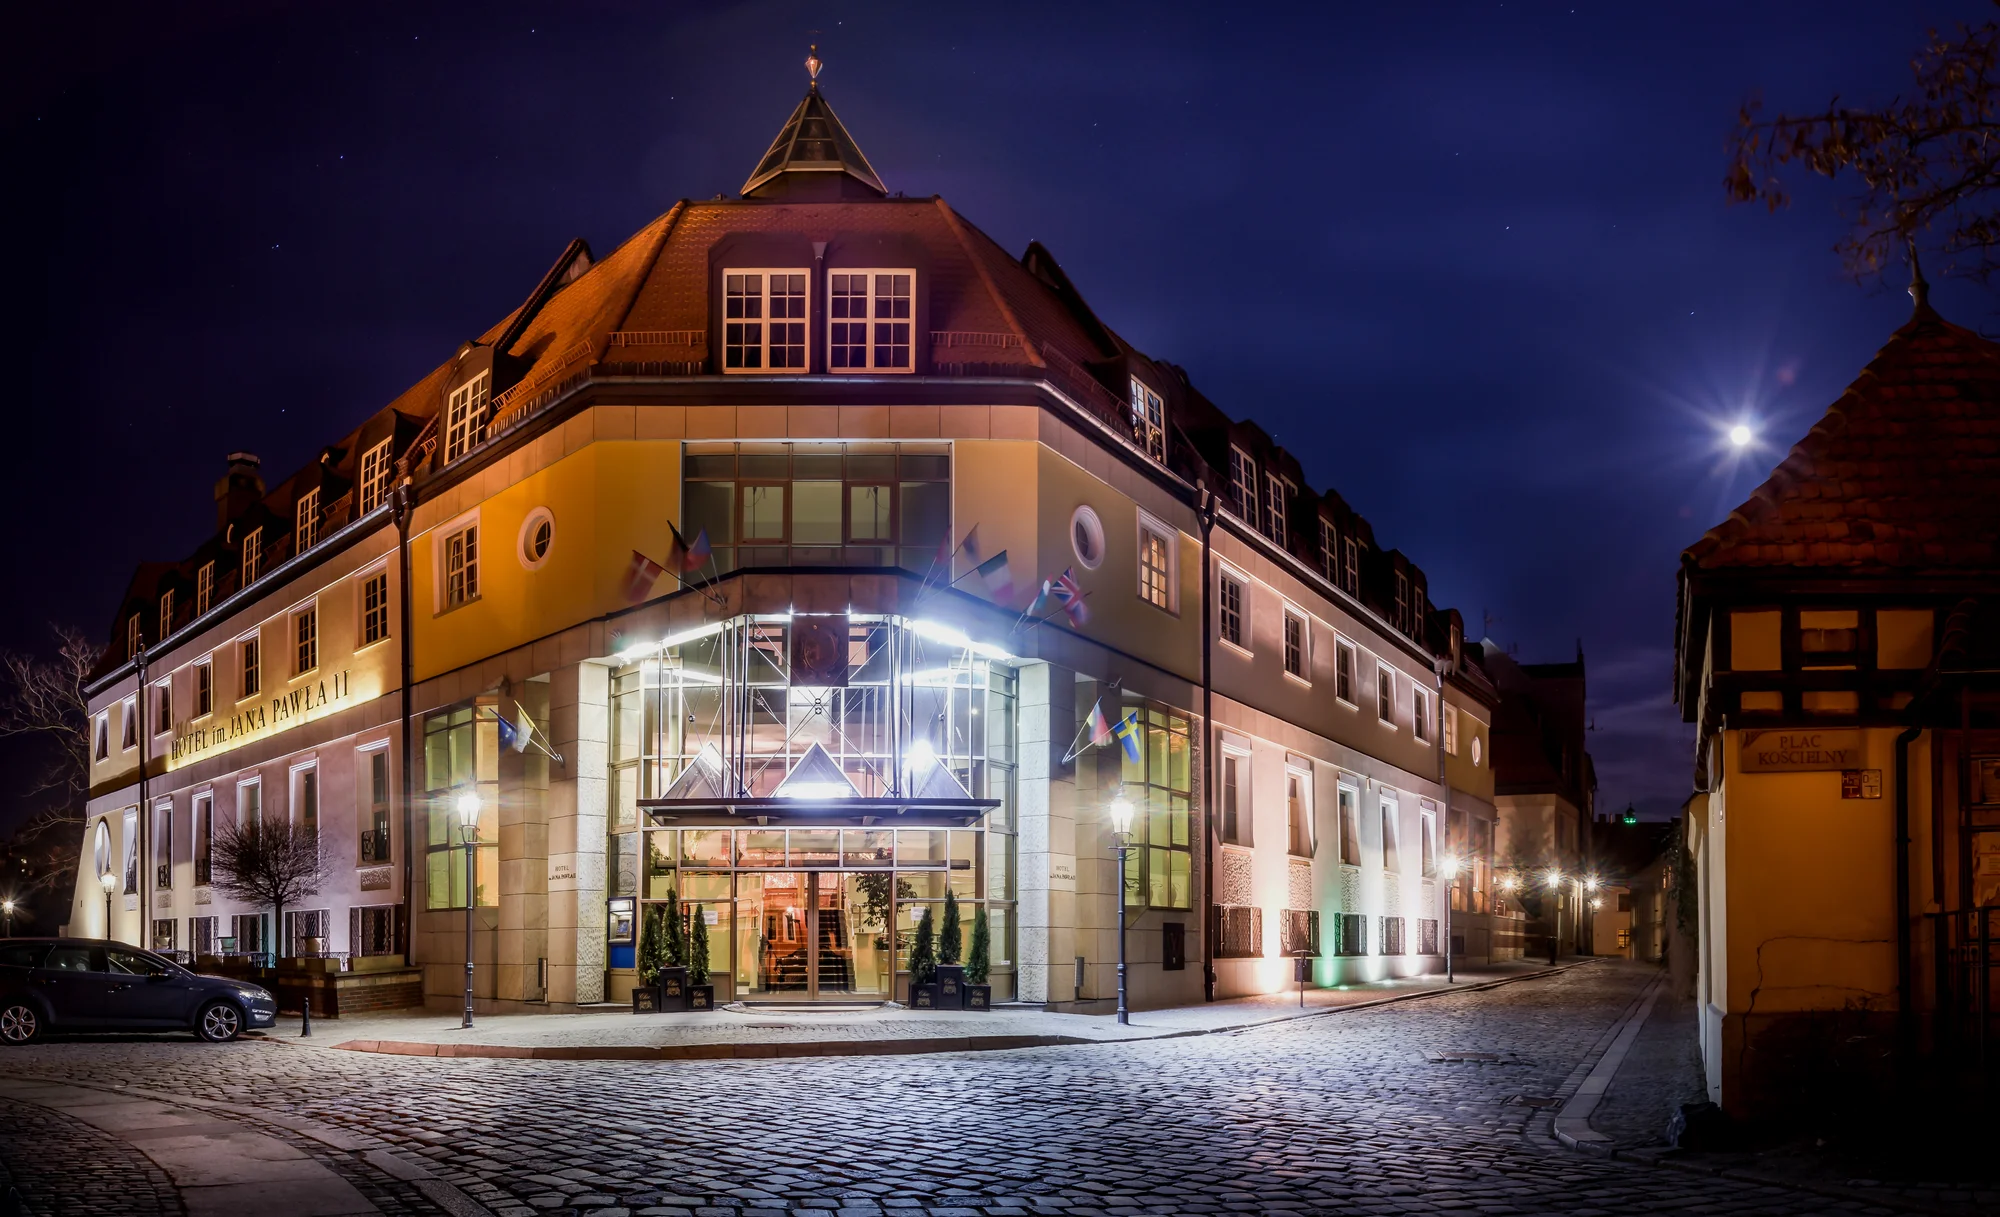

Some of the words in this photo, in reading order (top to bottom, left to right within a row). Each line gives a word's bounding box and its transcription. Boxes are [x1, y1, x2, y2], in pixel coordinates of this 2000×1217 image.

[171, 728, 208, 761] HOTEL
[212, 725, 227, 746] im.
[229, 705, 266, 739] JANA
[272, 680, 327, 723] PAWŁA
[334, 669, 351, 700] II
[1779, 734, 1821, 749] PLAC
[1758, 747, 1848, 766] KOŚCIELNY
